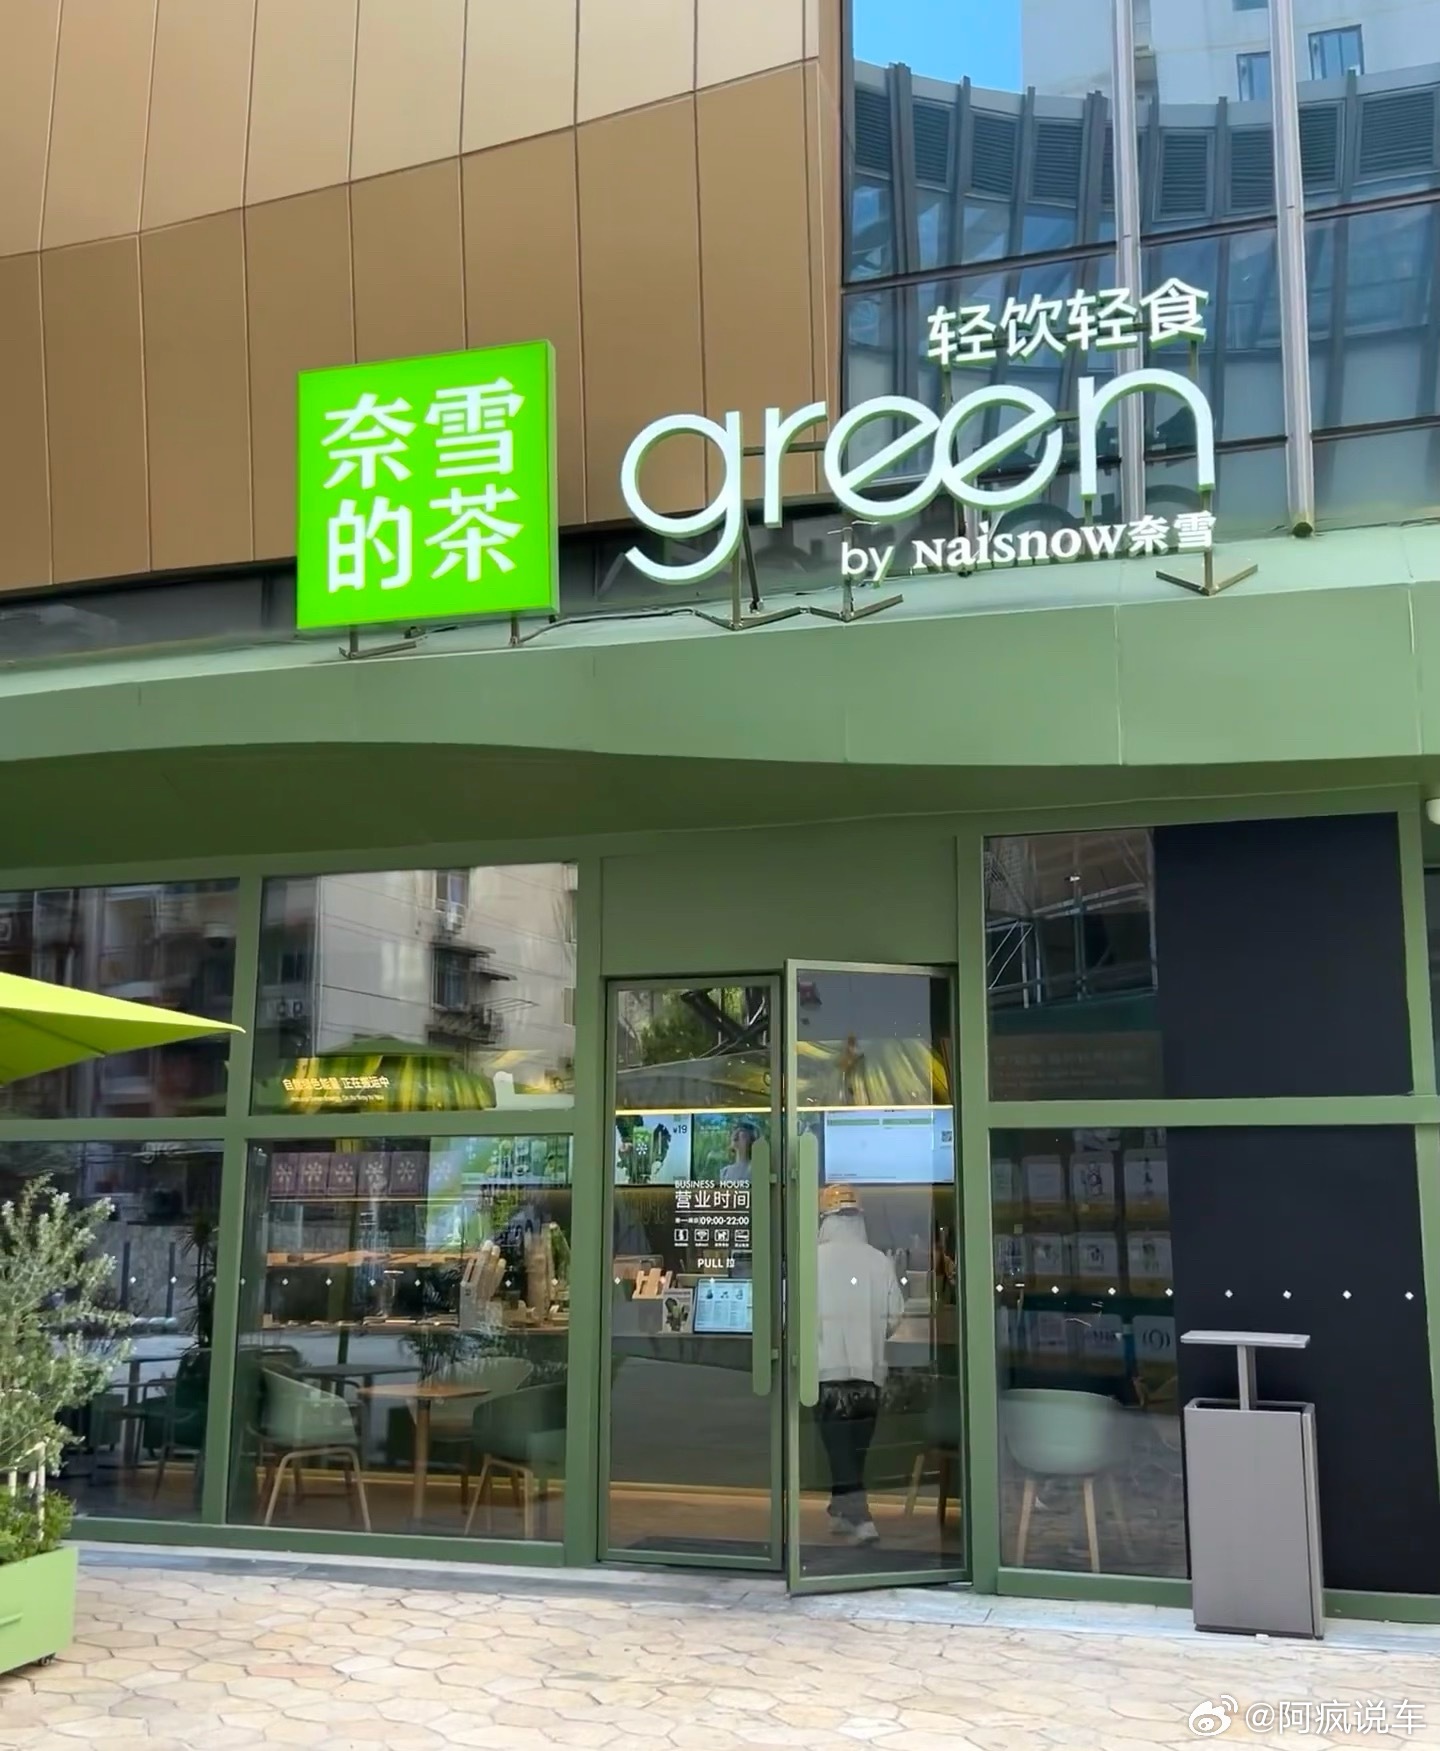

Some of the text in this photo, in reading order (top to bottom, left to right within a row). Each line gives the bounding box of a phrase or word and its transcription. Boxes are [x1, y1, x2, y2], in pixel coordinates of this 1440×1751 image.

[927, 277, 1209, 366] 轻饮轻食
[320, 377, 525, 490] 奈雪
[620, 368, 1216, 586] green
[327, 484, 525, 593] 的茶
[840, 542, 894, 586] by
[674, 1180, 750, 1189] BUSINESS HOURS
[675, 1189, 750, 1209] 营业时间
[700, 1216, 750, 1225] 09:00-22:00
[697, 1258, 724, 1269] PULL
